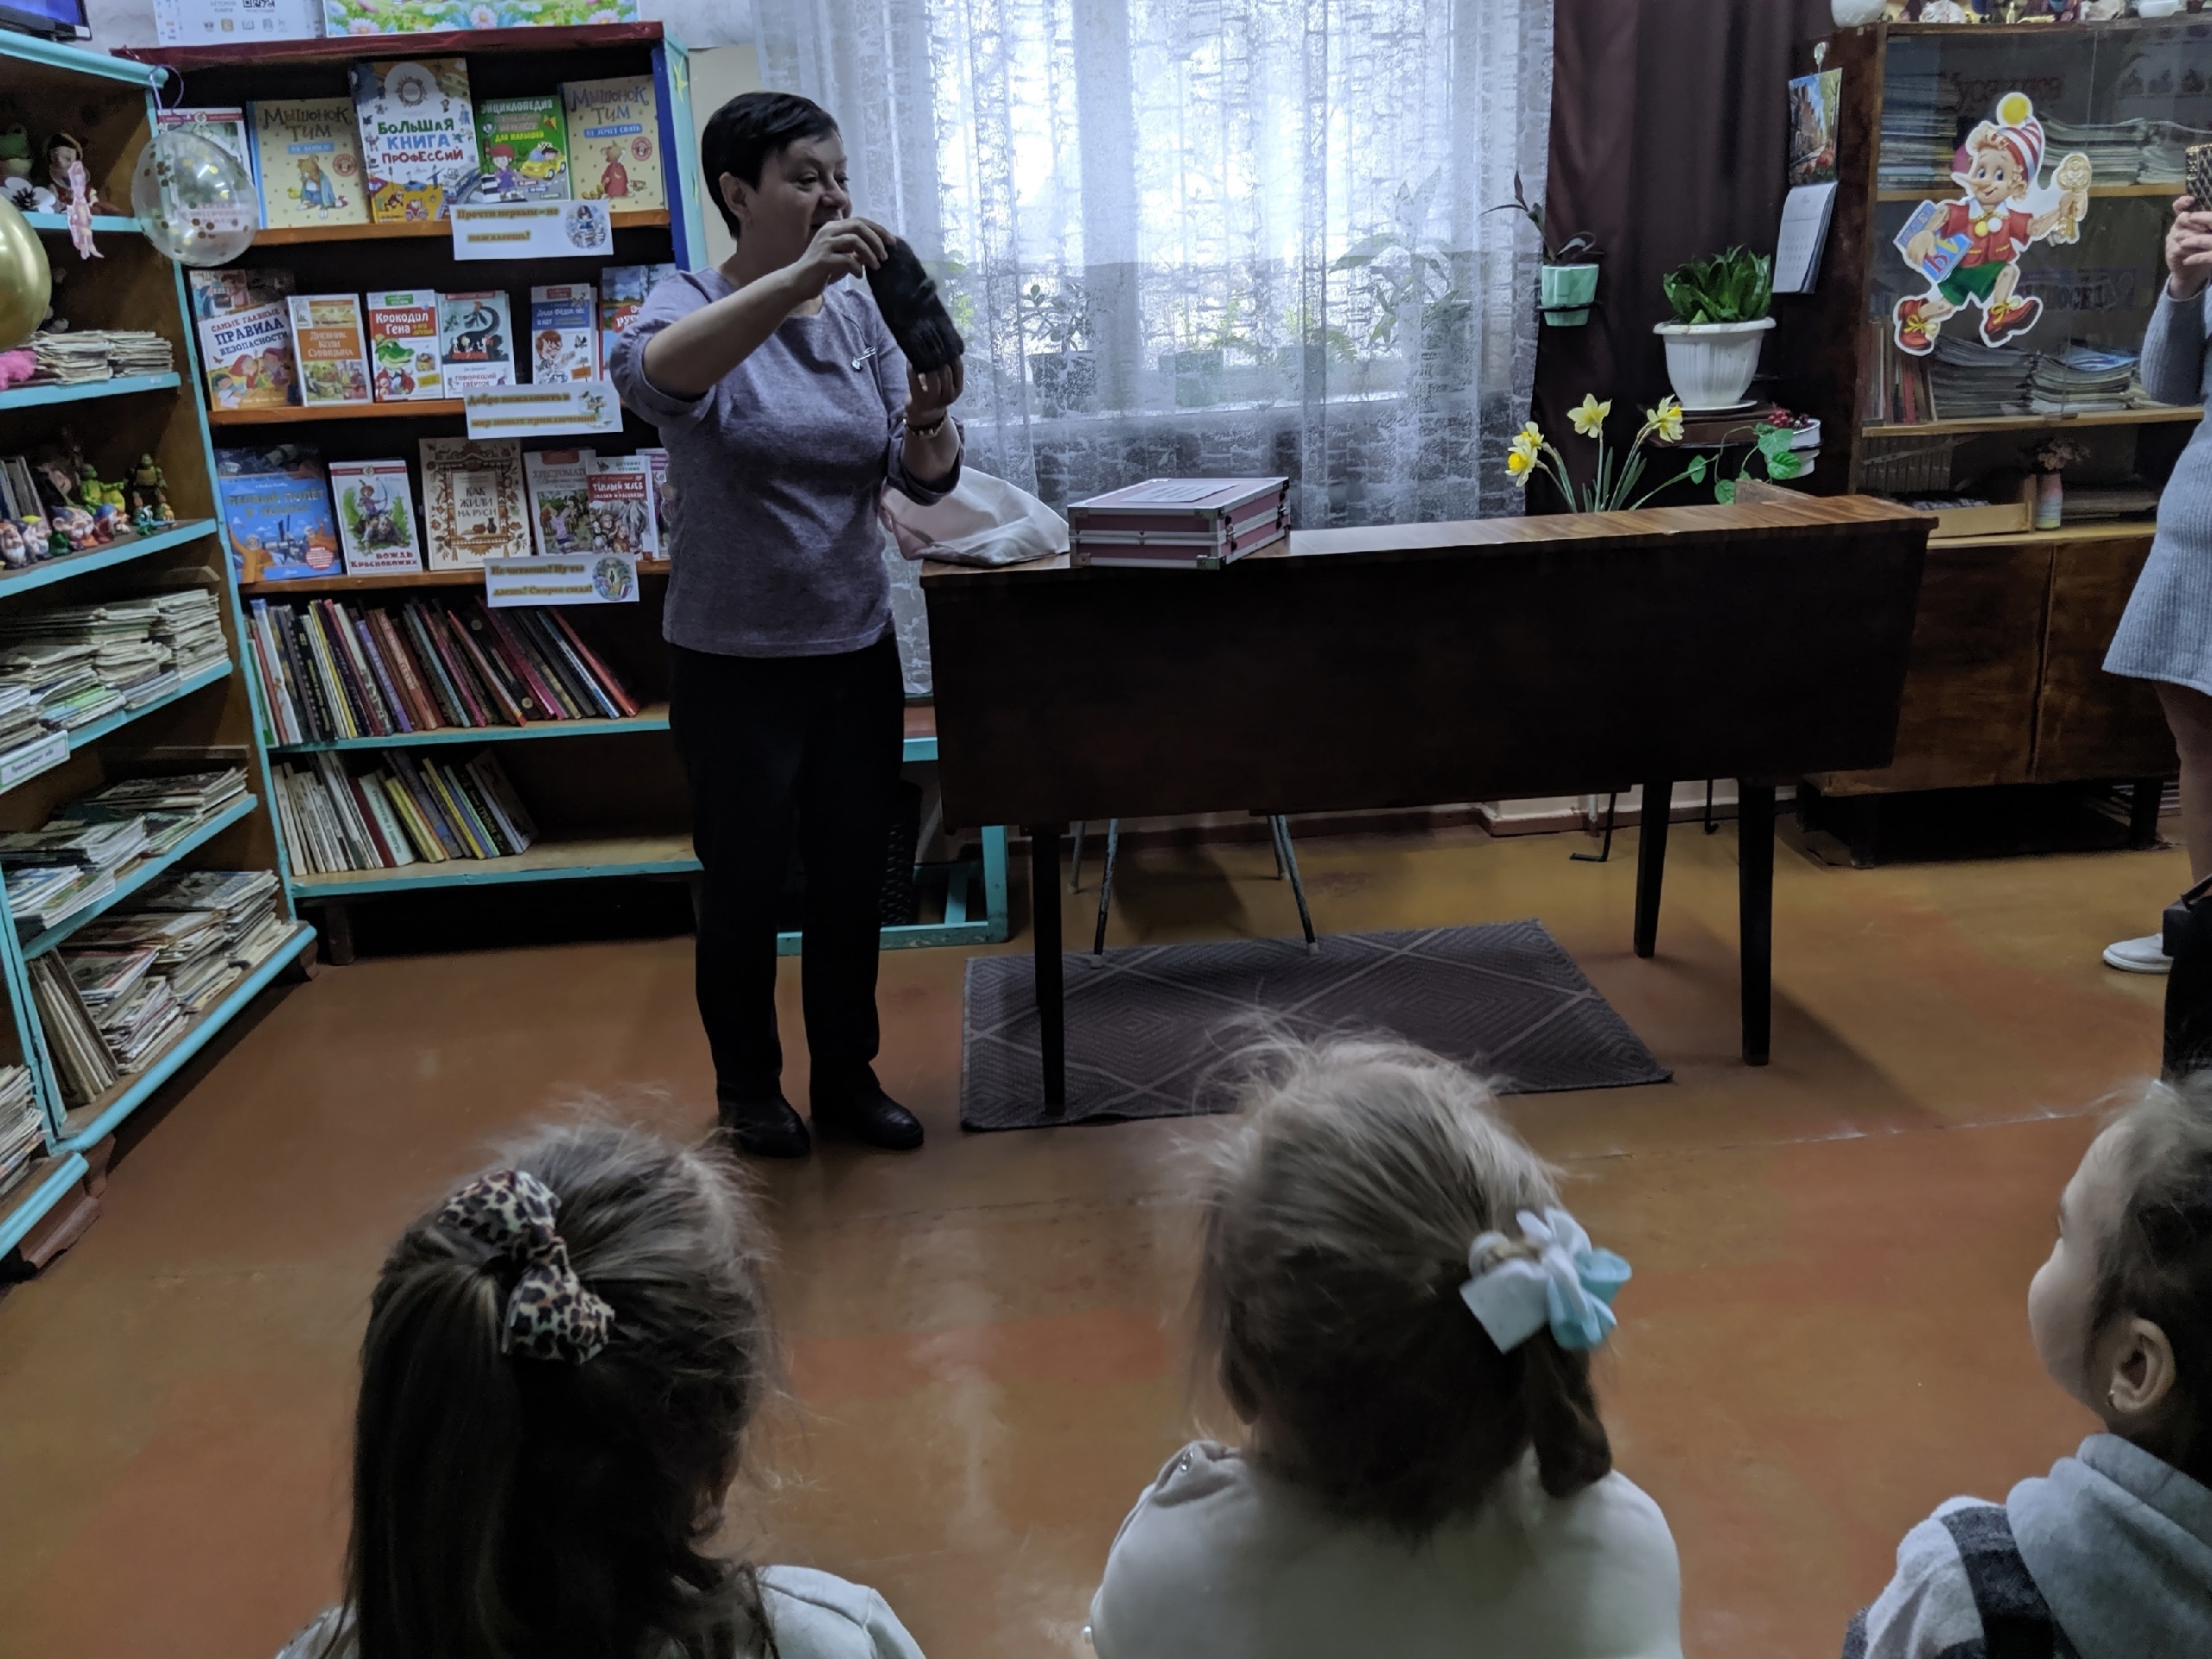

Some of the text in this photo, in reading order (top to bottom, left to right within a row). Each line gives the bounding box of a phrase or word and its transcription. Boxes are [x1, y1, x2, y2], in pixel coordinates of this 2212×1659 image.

[378, 118, 454, 135] БОЛЬШАЯ
[386, 133, 451, 150] КНИГА
[381, 146, 464, 164] ПРОФЕССИЙ
[211, 308, 281, 333] САМЫЕ ГЛАВНЫЕ
[214, 318, 285, 345] ПРАВИЛА
[219, 332, 289, 357] БЕЗОПАСНОСТИ
[466, 486, 486, 497] КАК
[459, 497, 493, 508] ЖИЛИ
